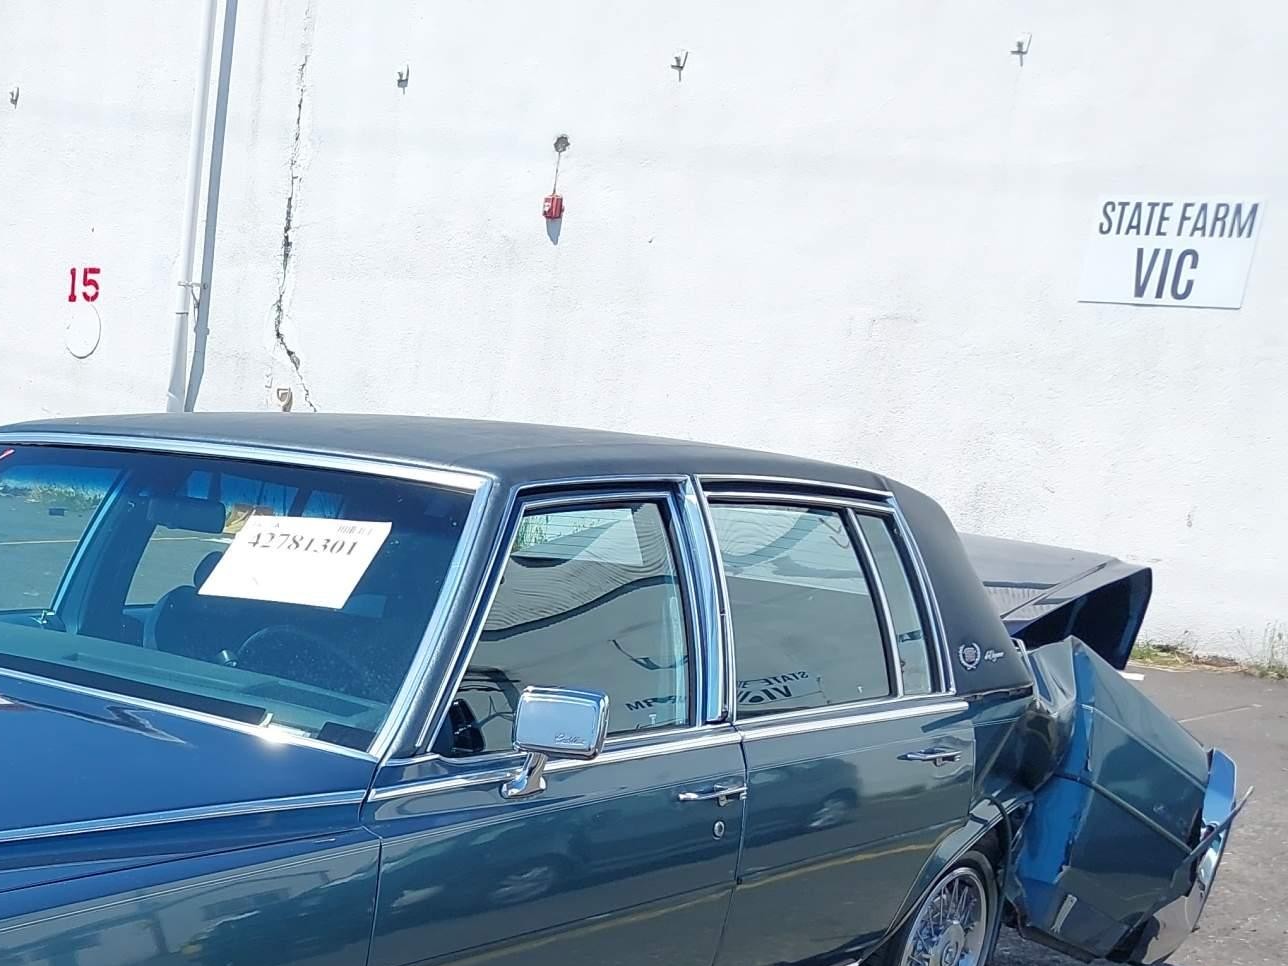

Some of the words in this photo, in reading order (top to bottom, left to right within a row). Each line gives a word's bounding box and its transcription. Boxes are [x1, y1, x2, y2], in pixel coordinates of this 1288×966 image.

[1098, 200, 1174, 236] STATE
[1176, 202, 1260, 239] FARM
[68, 267, 101, 303] 15
[1133, 247, 1200, 301] VIC
[247, 531, 360, 556] 42781301
